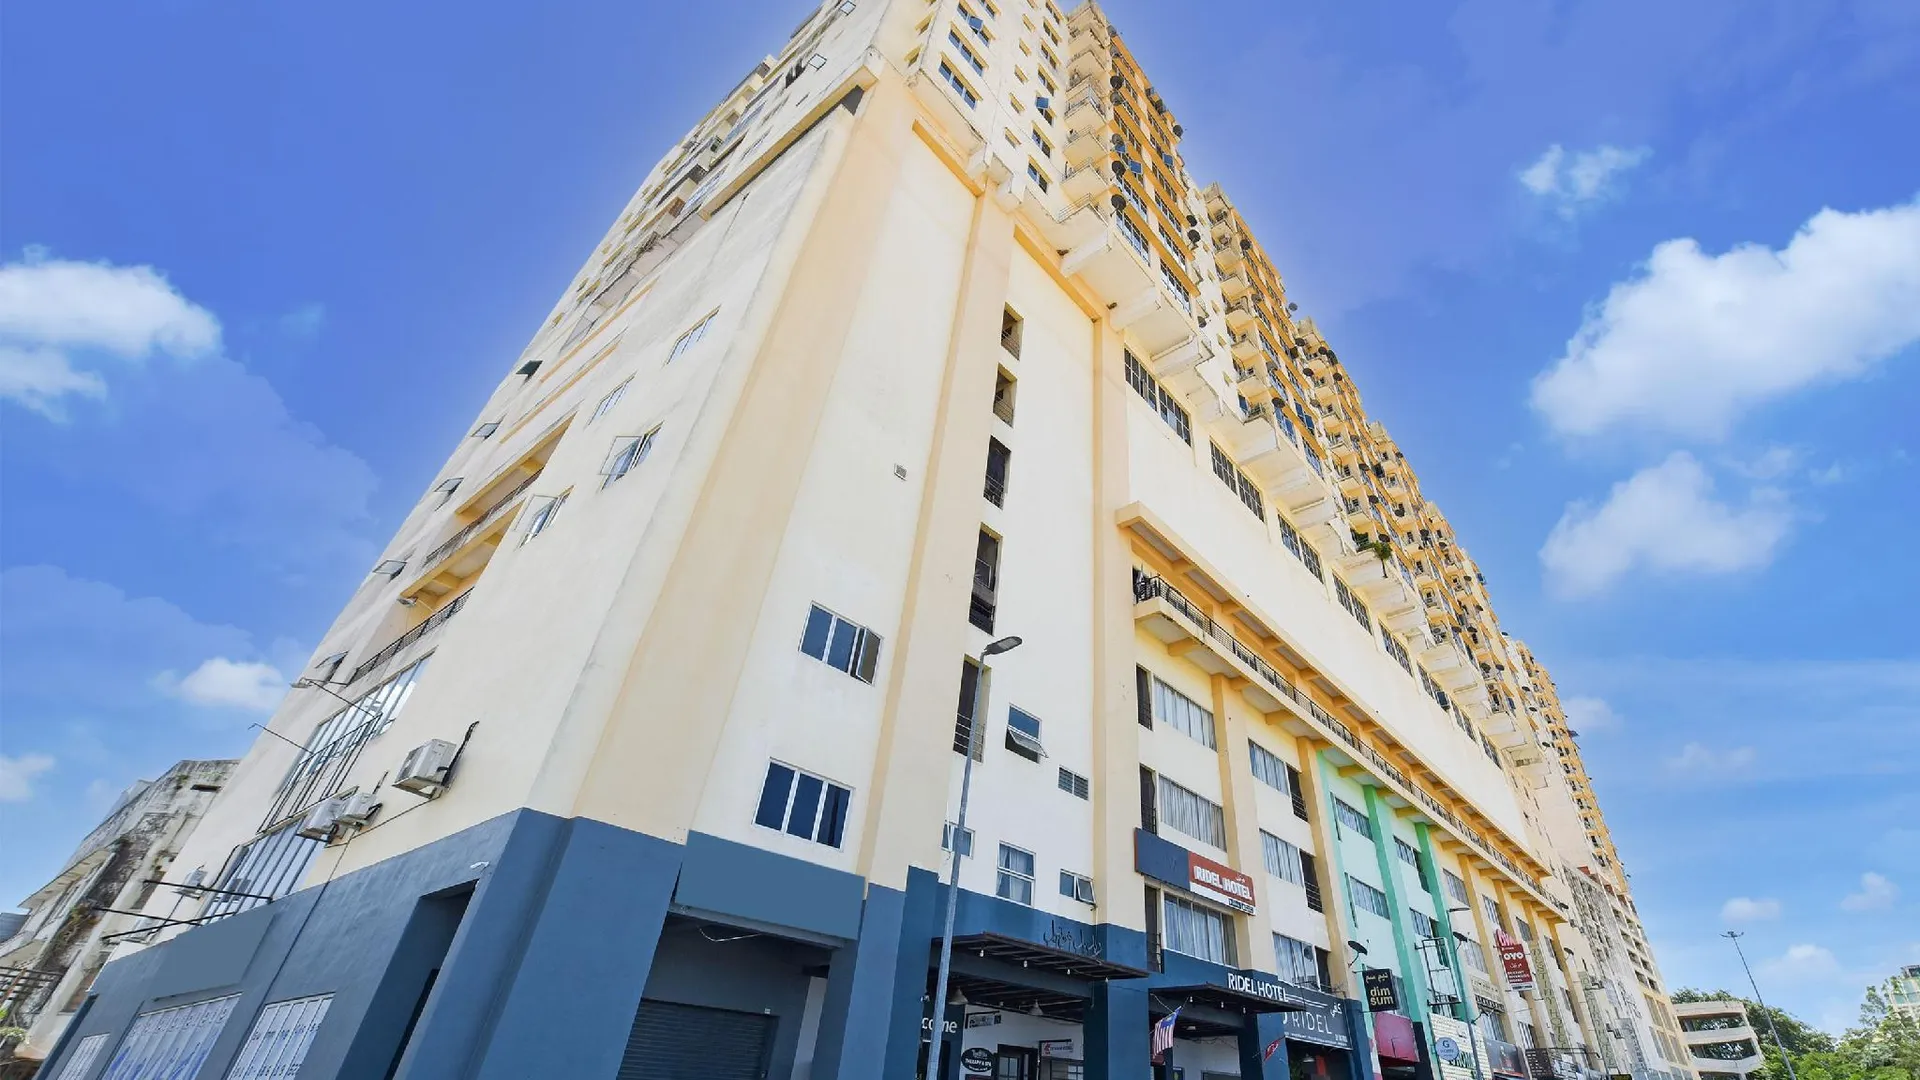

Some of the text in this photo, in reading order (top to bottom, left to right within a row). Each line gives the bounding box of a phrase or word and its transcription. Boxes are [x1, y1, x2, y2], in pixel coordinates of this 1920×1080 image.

[1193, 866, 1222, 888] RIDEL
[1222, 878, 1252, 900] HOTEL
[1504, 952, 1523, 960] OYO
[1228, 972, 1288, 1002] RIDEL HOTEL
[1370, 986, 1391, 997] dim
[1370, 996, 1394, 1006] sum
[1291, 1011, 1332, 1035] RIDEL
